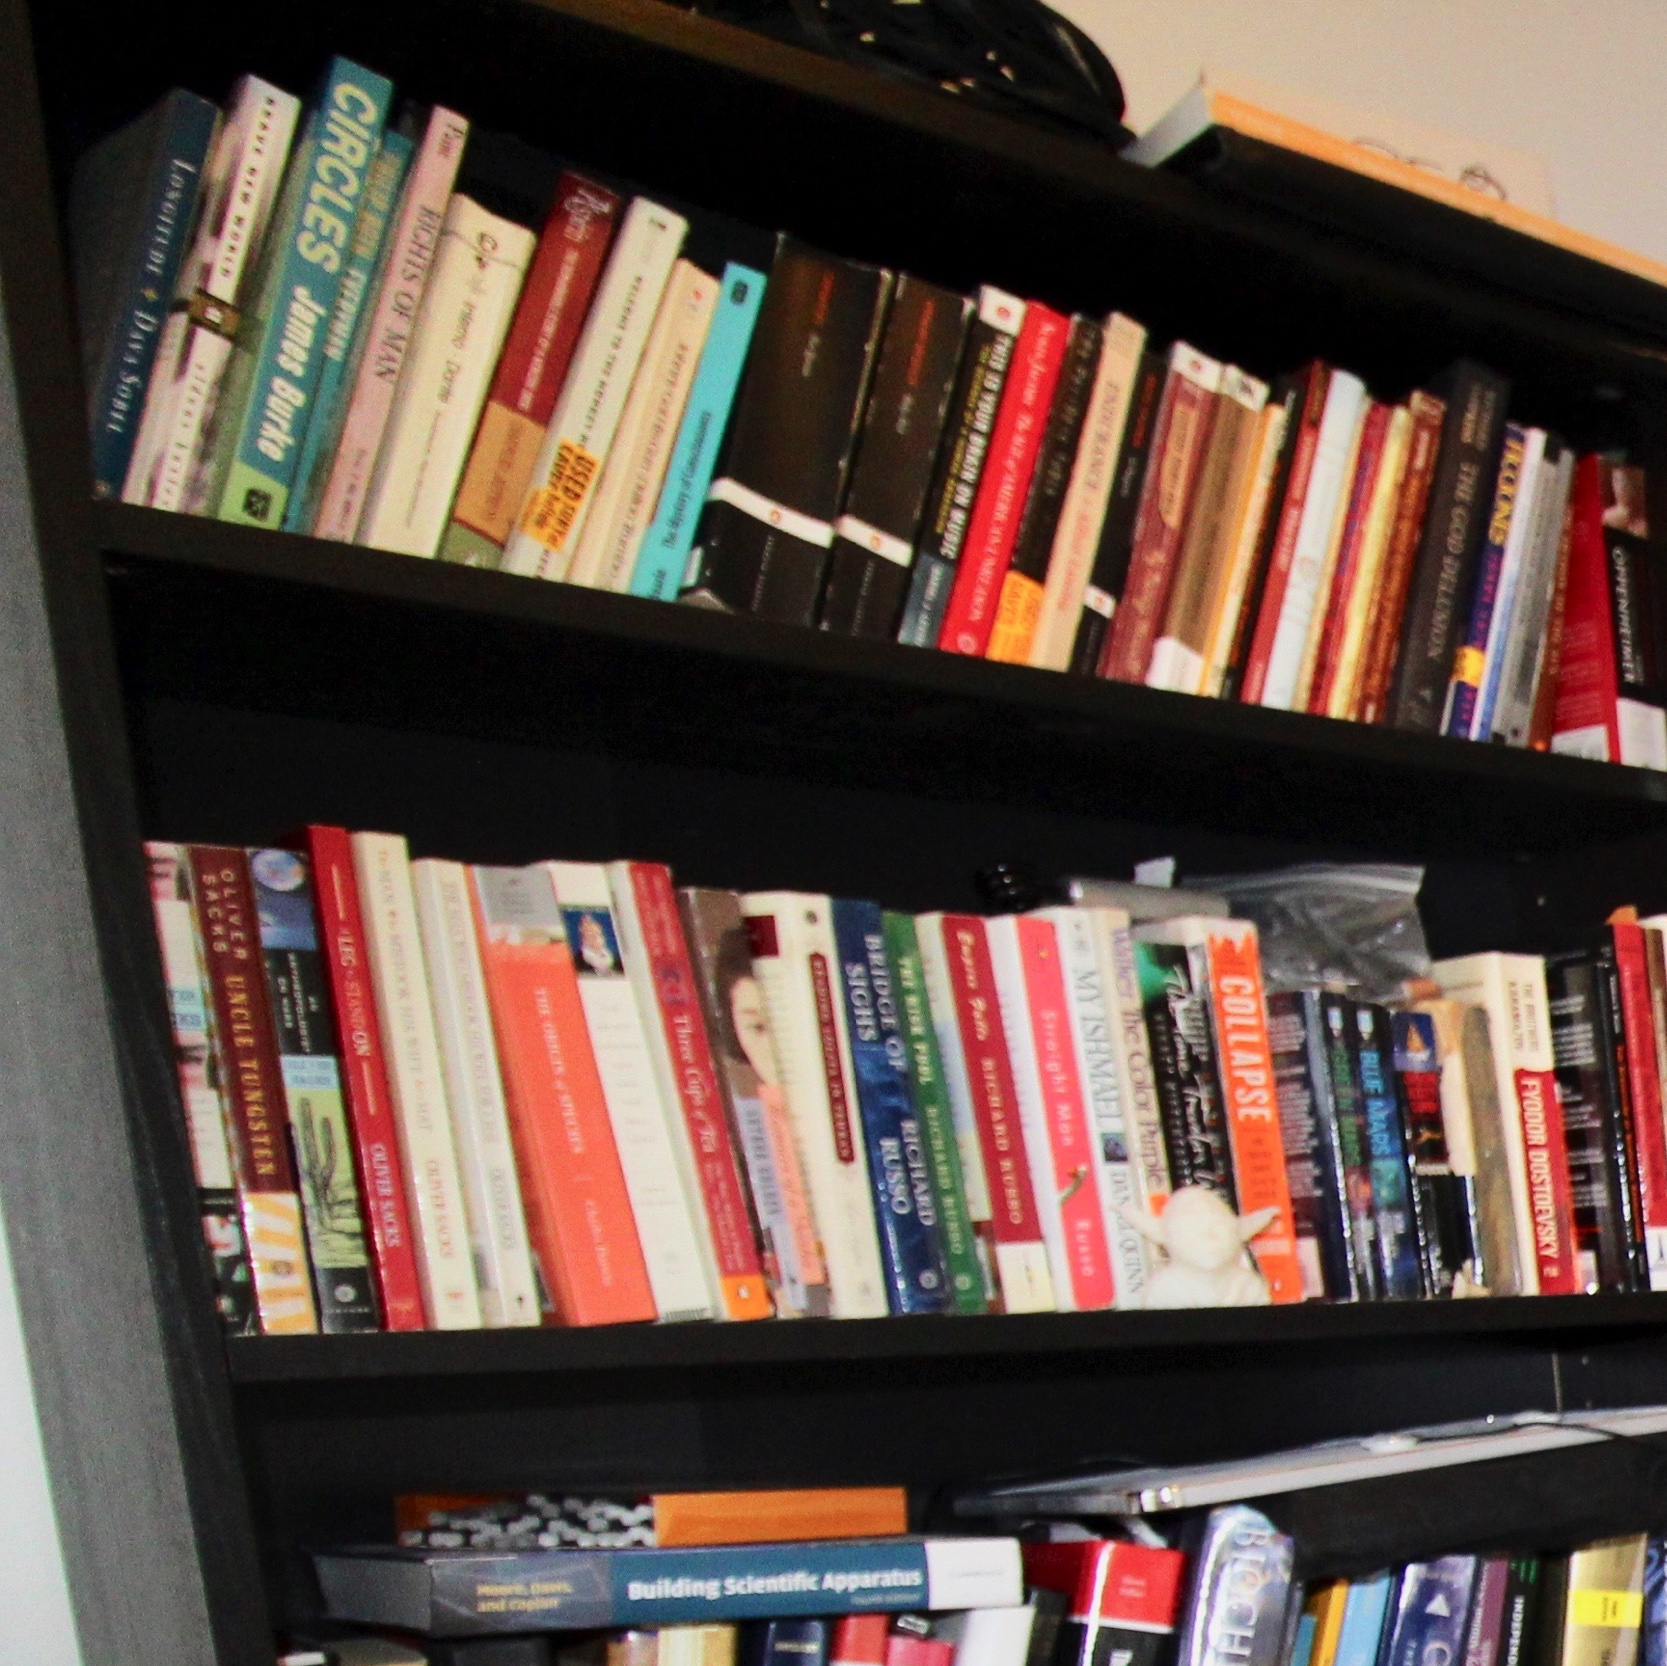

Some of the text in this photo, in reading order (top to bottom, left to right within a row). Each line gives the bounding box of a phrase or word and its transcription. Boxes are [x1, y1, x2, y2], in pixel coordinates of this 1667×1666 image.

[214, 96, 281, 280] BRAVE NEW WORLD
[254, 80, 379, 464] CIRCLES James Burke
[323, 266, 369, 363] EVERYMAN
[372, 204, 442, 384] RIGHTS OF MAN
[436, 359, 461, 404] Dante
[560, 453, 596, 504] USED
[938, 334, 1010, 561] THIS IS YOUR BRAIN ON MUSIC
[1422, 462, 1478, 659] THE GOD DELUSION
[1606, 545, 1641, 684] OPPENHEIMER
[202, 873, 228, 954] SACKS
[220, 868, 249, 963] OLIVER
[1109, 927, 1140, 997] Walker
[844, 965, 877, 1039] SIGHS
[863, 936, 906, 1069] BRIDGE OF
[968, 994, 995, 1040] Falls
[1122, 1007, 1149, 1047] The
[1207, 973, 1277, 1128] COLLAPSE
[222, 977, 277, 1174] UNCLE TUNGSTEN
[673, 1014, 715, 1154] Three Cups Tea
[895, 955, 965, 1255] THE RISK POOL RICHARD RUSSO
[973, 1057, 1016, 1151] RICHARD
[1129, 1050, 1159, 1112] Color
[1358, 1049, 1392, 1156] BLUE MARS
[1520, 1076, 1547, 1146] FYODOR
[880, 1138, 912, 1211] RUSSO
[899, 1121, 937, 1223] RICHARD
[1035, 1007, 1101, 1276] Straight Man Russo
[1074, 969, 1148, 1294] MY ISHMAEL QUINN
[1137, 1120, 1171, 1189] Purple
[369, 1141, 401, 1248] OLIVER SACKS
[423, 1157, 448, 1210] OLIVER
[994, 1157, 1027, 1224] RUSSO
[1528, 1147, 1560, 1259] DOSTOEVSKY
[628, 1576, 720, 1604] Building
[723, 1571, 819, 1598] Scientific
[821, 1567, 922, 1593] Apparatus
